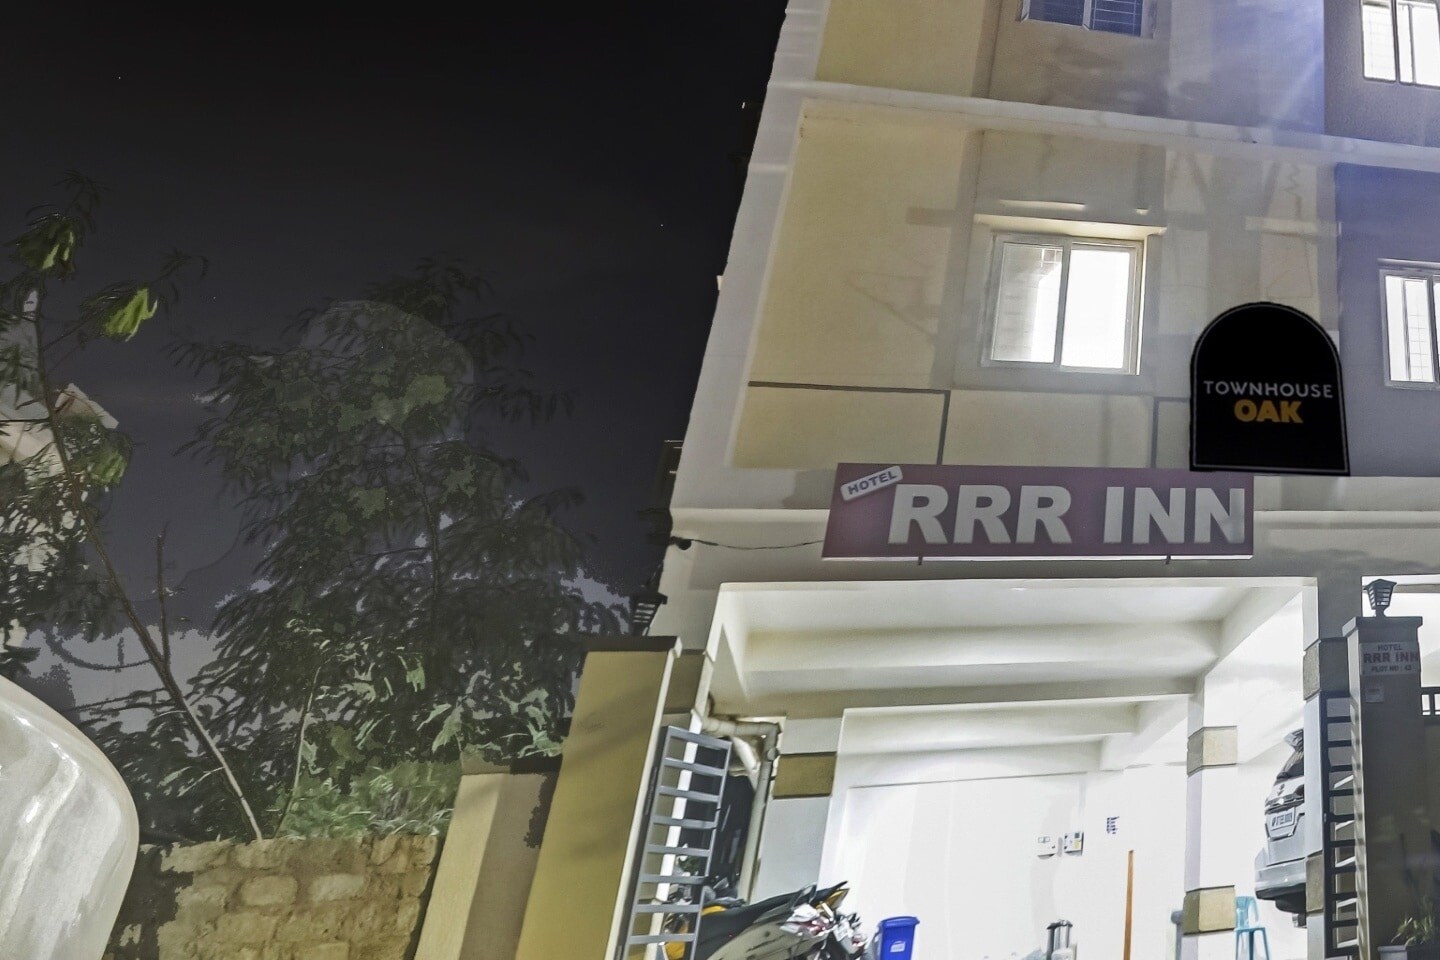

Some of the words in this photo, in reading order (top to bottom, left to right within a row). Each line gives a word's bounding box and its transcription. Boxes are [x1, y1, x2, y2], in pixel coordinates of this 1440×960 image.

[1203, 380, 1333, 398] TOWNHOUSE
[1234, 399, 1303, 423] OAK
[848, 470, 898, 495] HOTEL
[888, 484, 1072, 544] RRR
[1103, 486, 1245, 544] INN
[1363, 652, 1391, 663] RRR
[1395, 651, 1419, 662] INN
[1377, 643, 1402, 651] HOTEL
